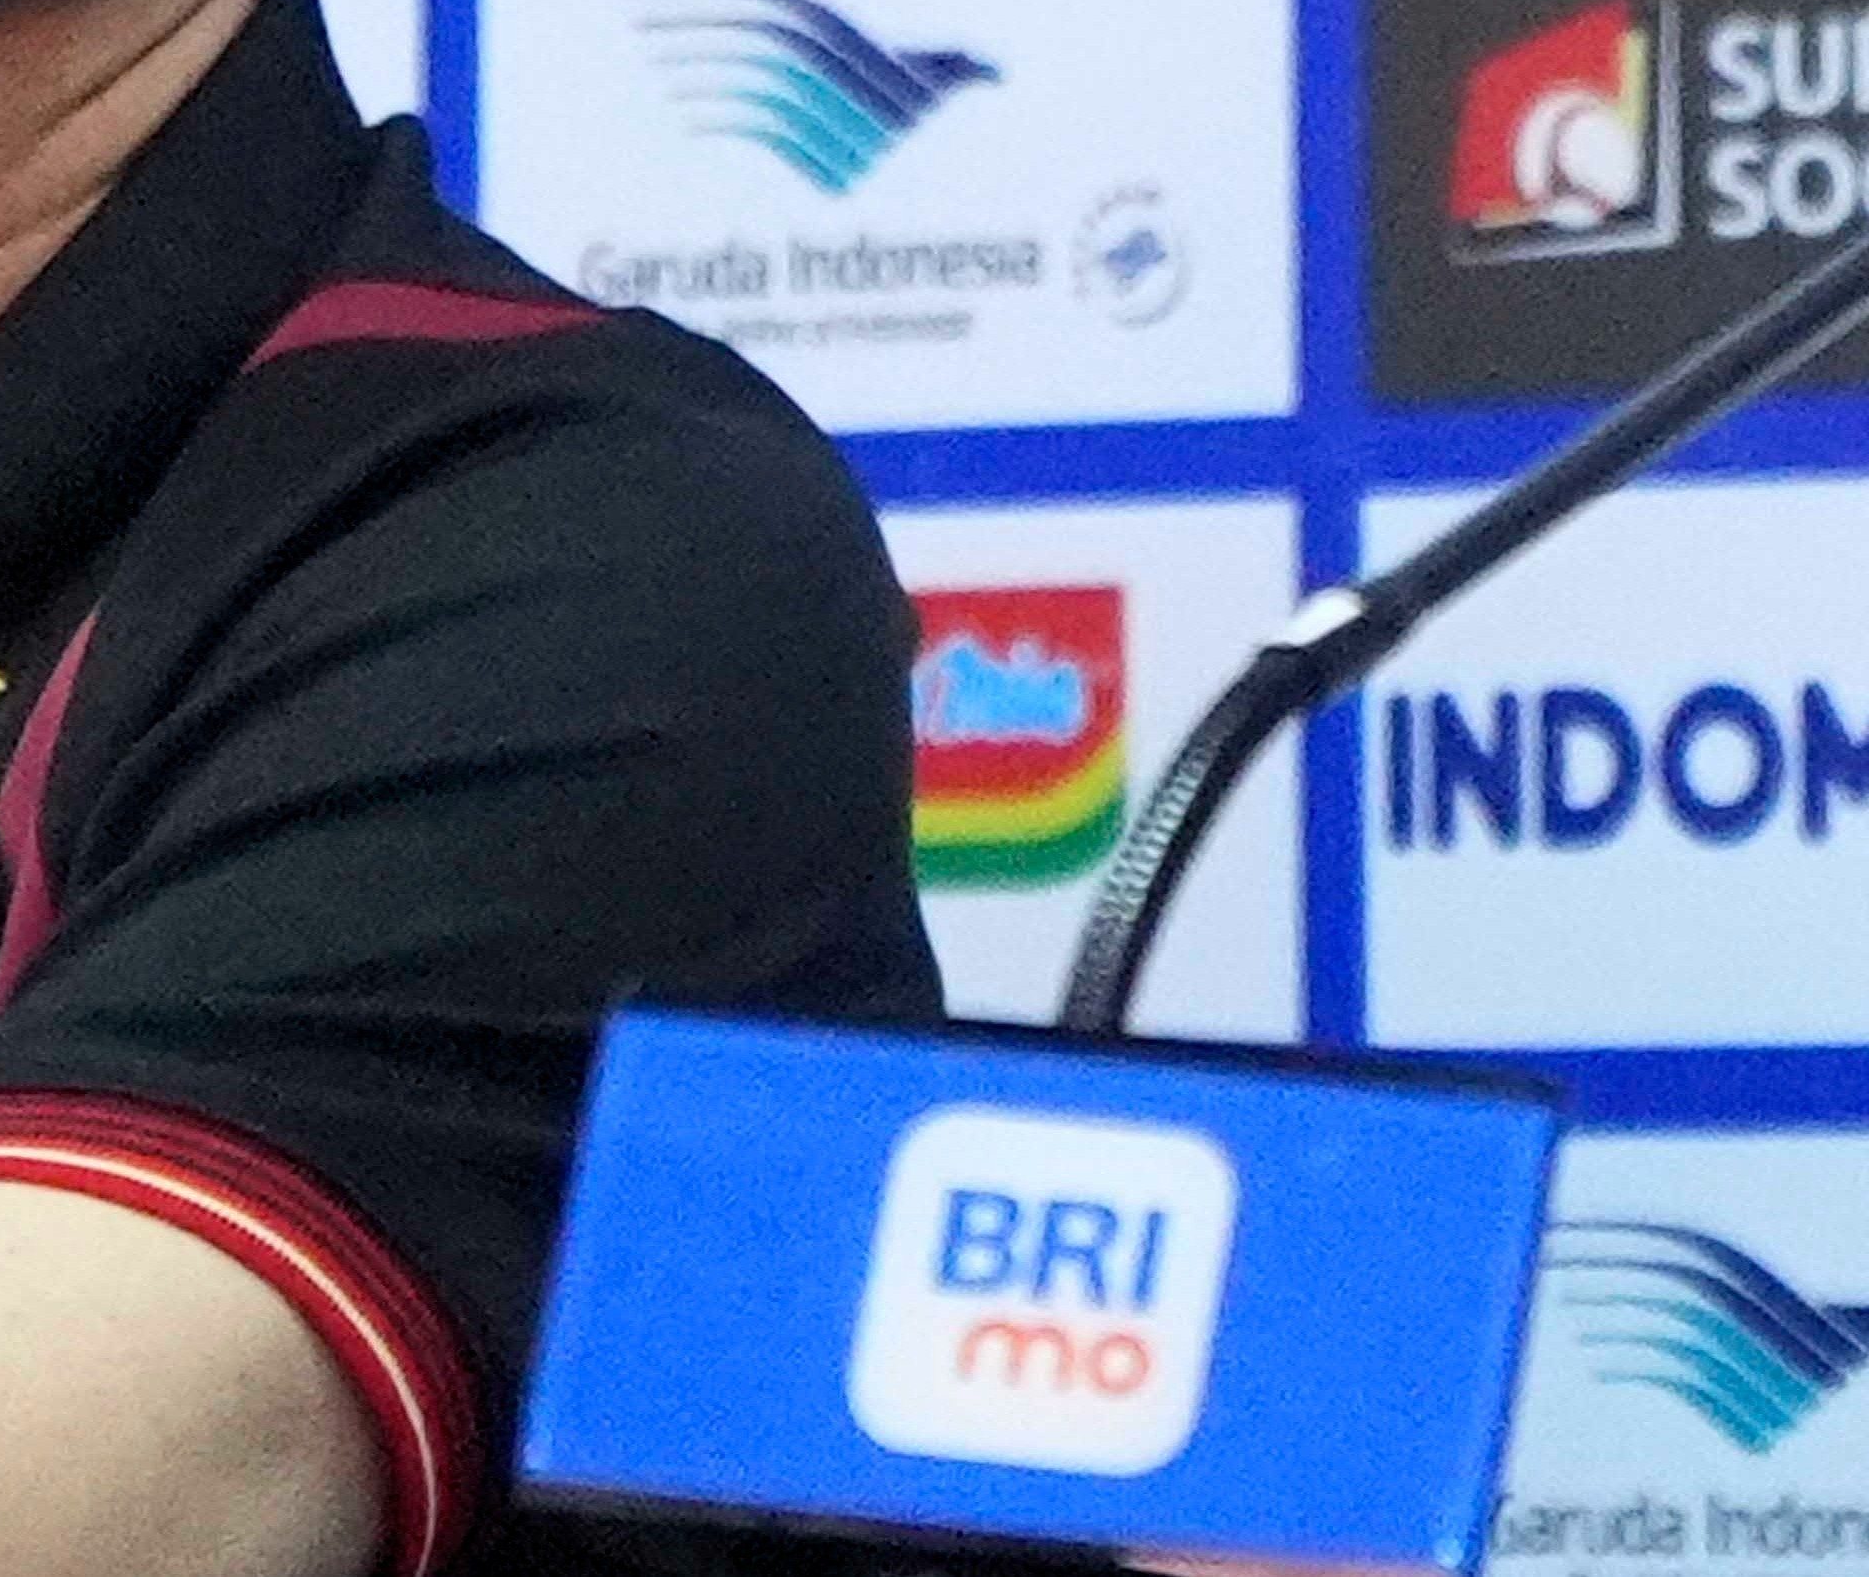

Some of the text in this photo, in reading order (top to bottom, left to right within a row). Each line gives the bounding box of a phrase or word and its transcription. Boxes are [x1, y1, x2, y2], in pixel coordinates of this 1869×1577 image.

[577, 238, 771, 308] Garuda
[787, 232, 1043, 295] Indonesia
[934, 1186, 1169, 1311] BRI
[955, 1312, 1155, 1397] mo
